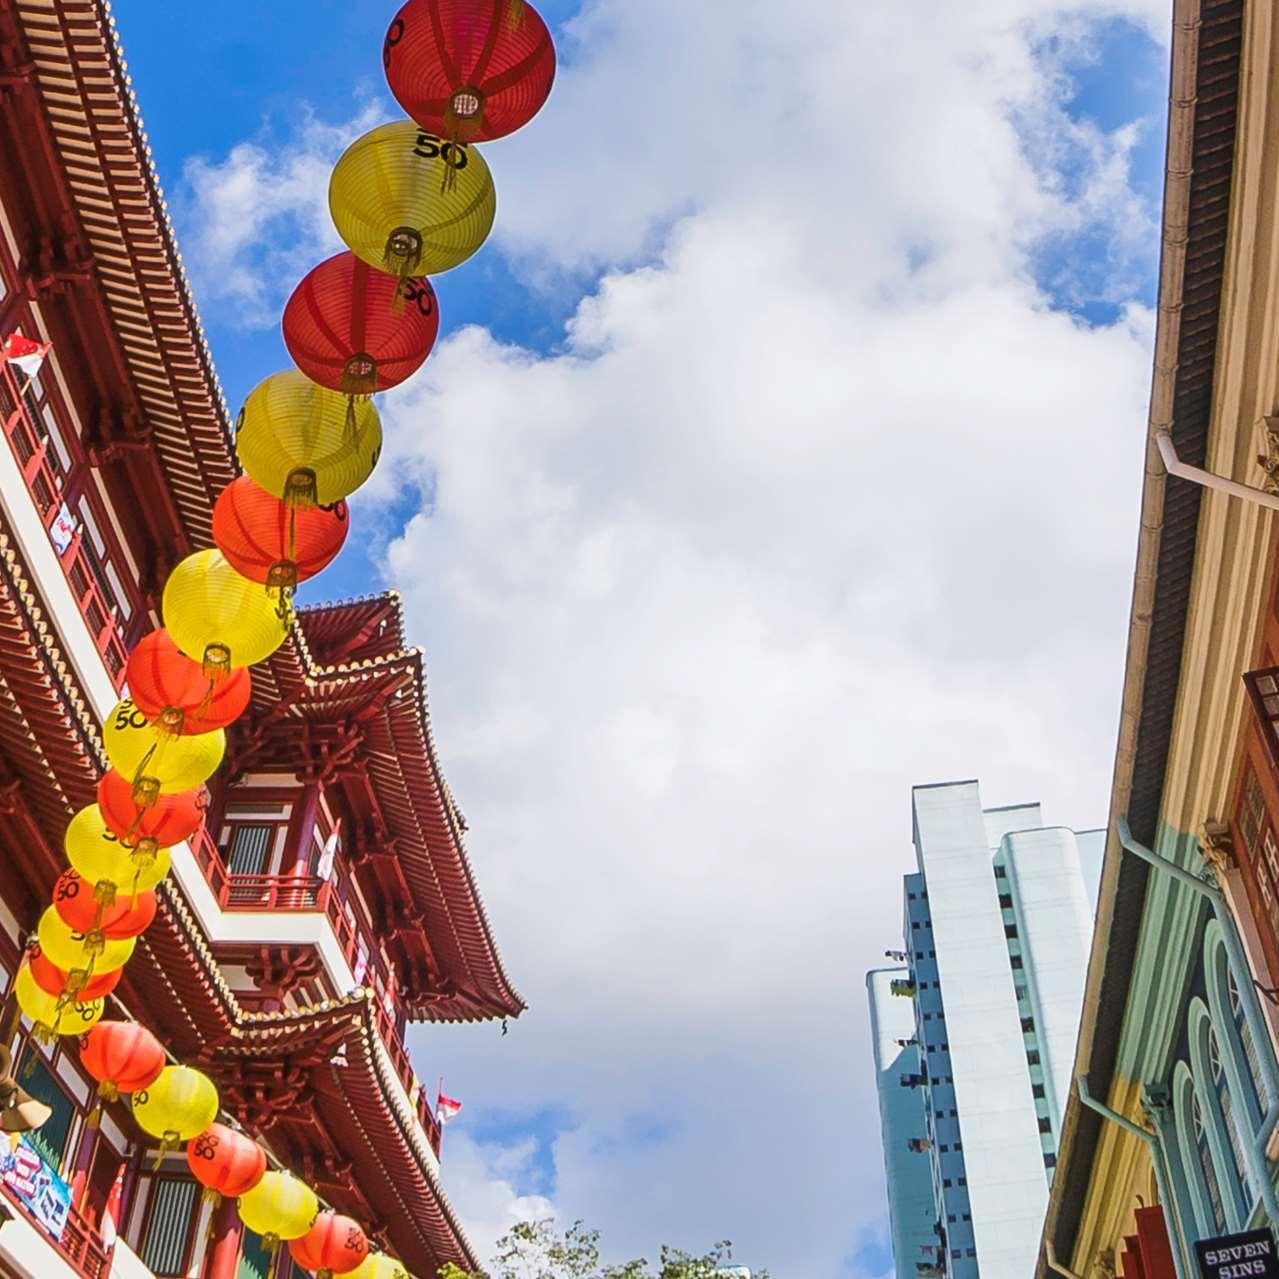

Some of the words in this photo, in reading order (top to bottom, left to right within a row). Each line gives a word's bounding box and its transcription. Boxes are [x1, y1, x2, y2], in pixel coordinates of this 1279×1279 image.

[412, 134, 468, 171] 50
[114, 710, 148, 730] 50
[194, 1142, 215, 1160] 50
[1205, 1240, 1271, 1265] SEVEN
[1218, 1259, 1266, 1279] SINS
